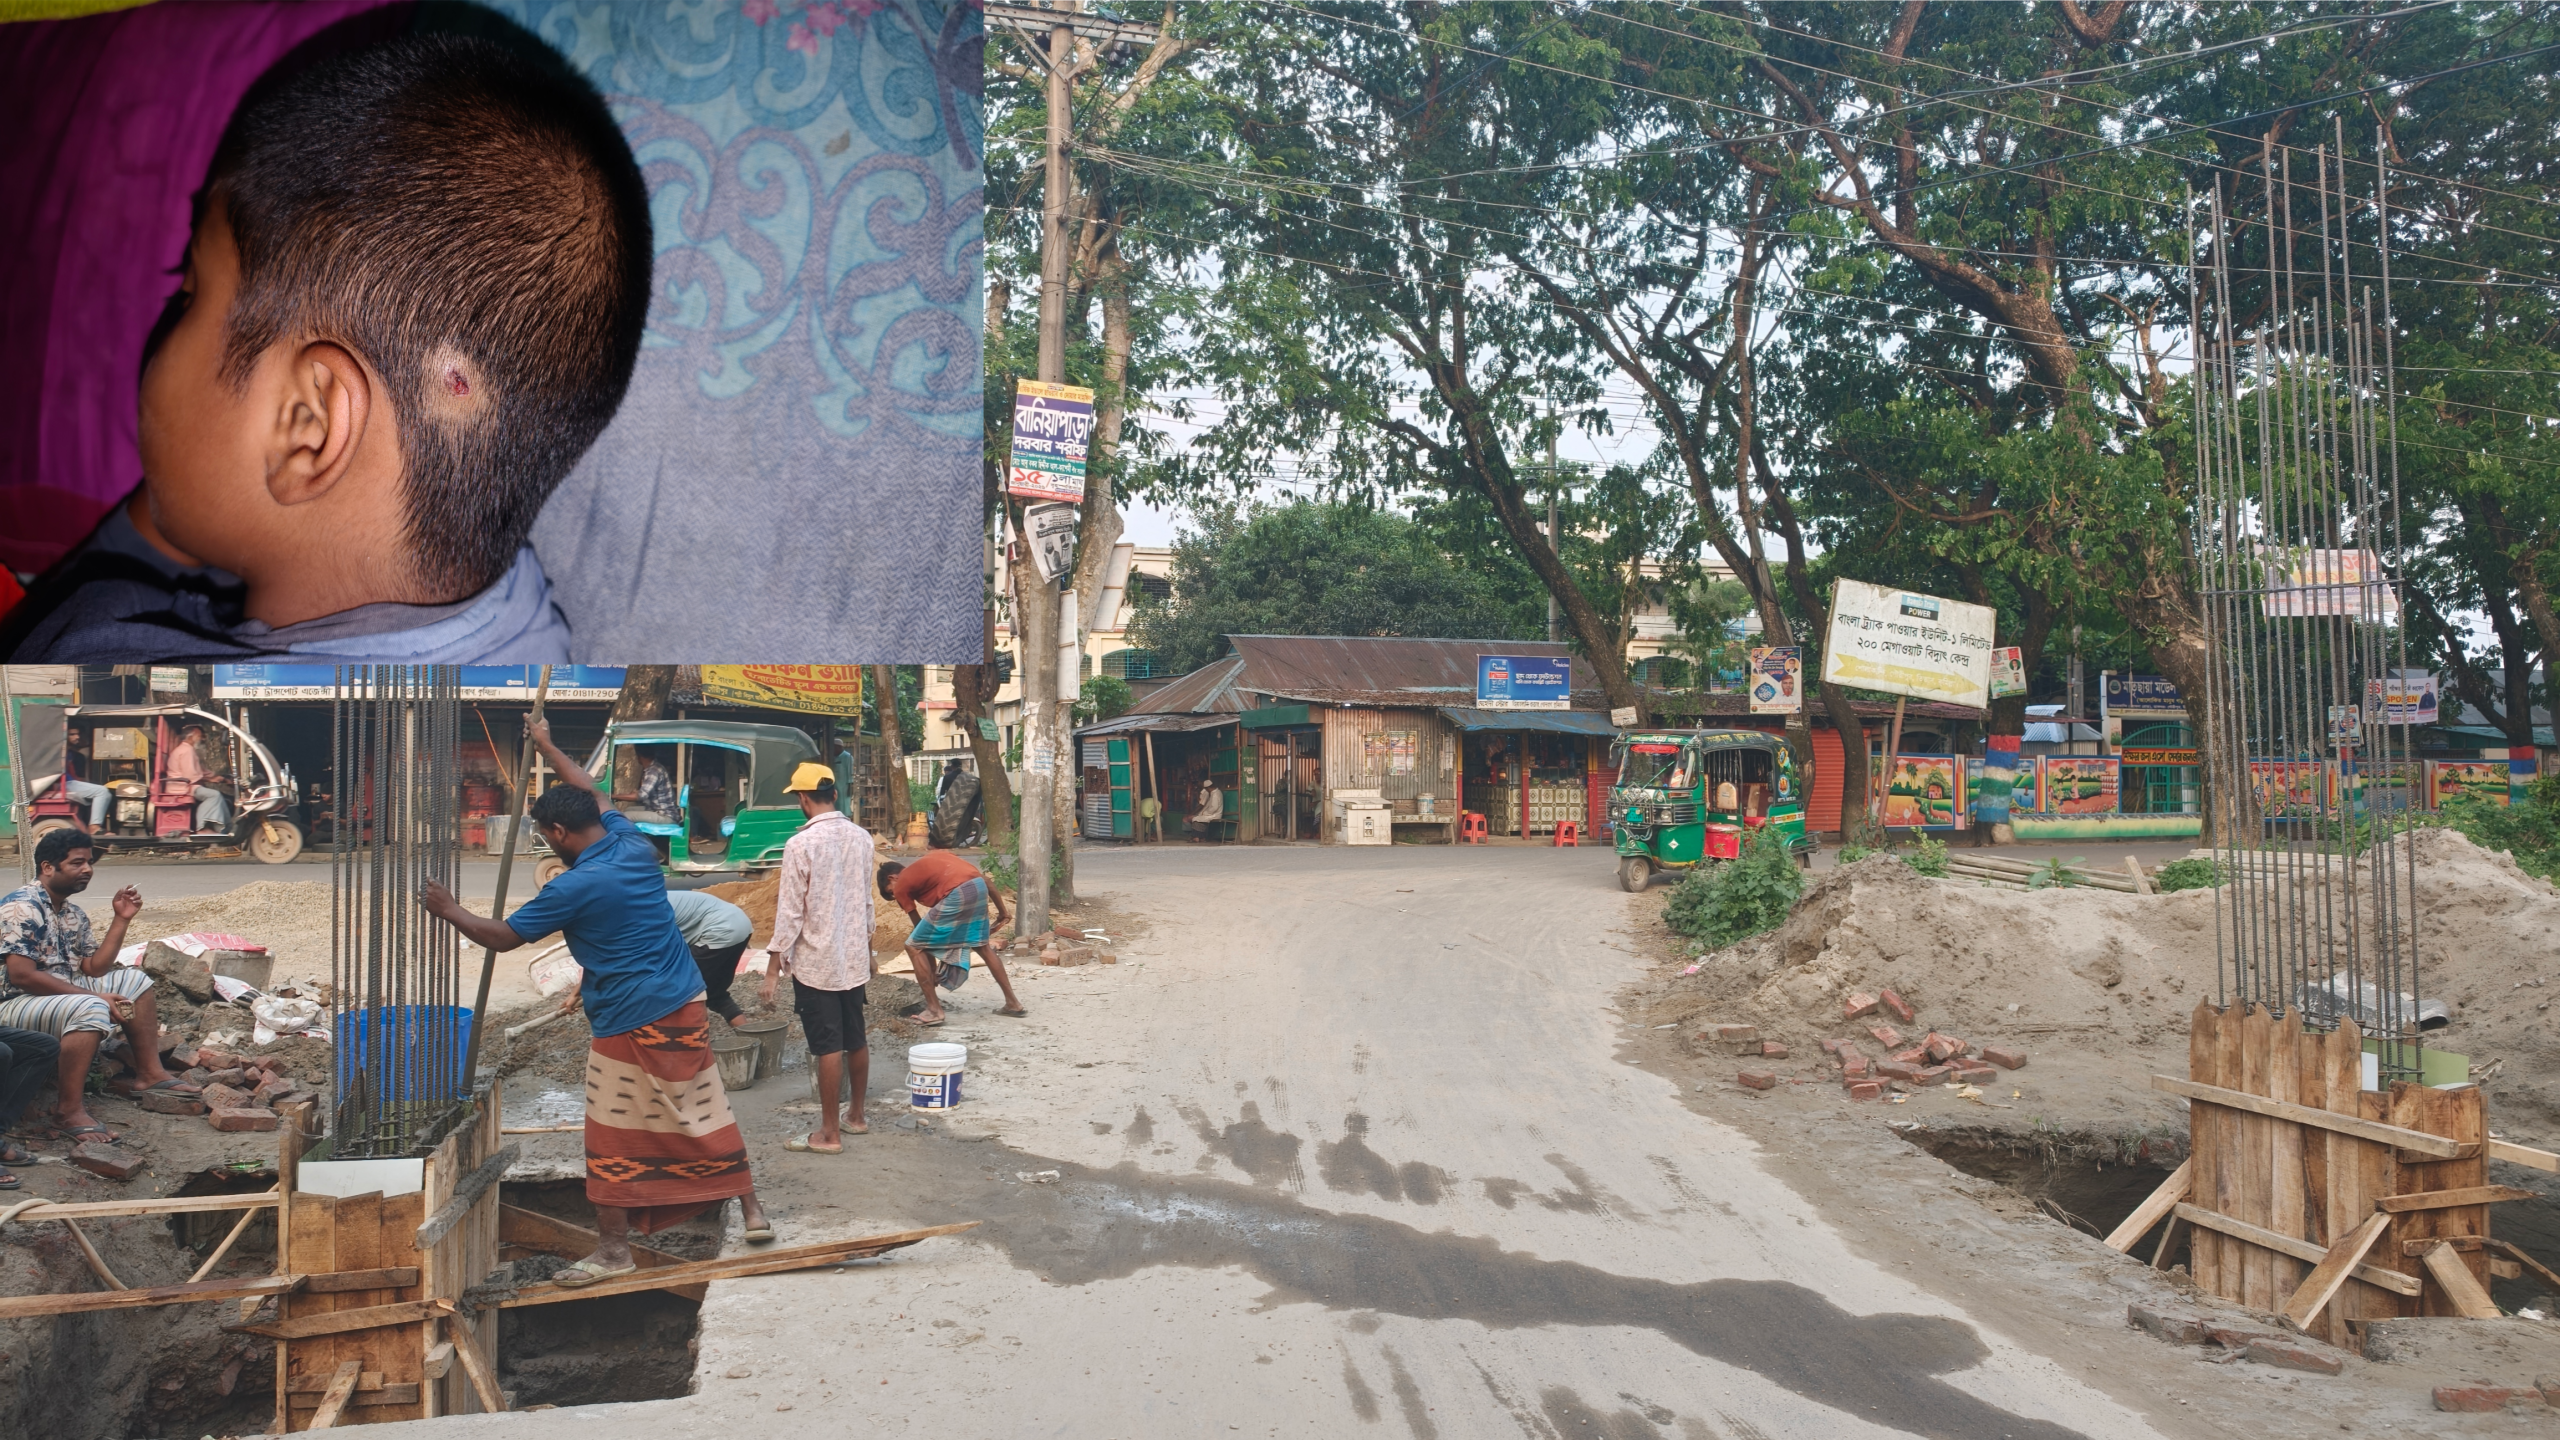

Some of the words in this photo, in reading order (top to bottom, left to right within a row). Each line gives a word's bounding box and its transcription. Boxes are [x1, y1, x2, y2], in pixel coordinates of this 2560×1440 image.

[1016, 397, 1090, 444] বানিয়াপাড়া
[1014, 436, 1052, 452] দরবার
[1055, 438, 1087, 457] শরীফ
[1014, 468, 1044, 484] ১৫
[1052, 474, 1072, 484] ১লা
[1908, 607, 1931, 618] POWER
[1838, 614, 1861, 627] বাংলা
[1887, 622, 1919, 638] পাওয়ার
[1921, 626, 1957, 645] ইউনিট-১
[1960, 633, 1992, 650] লিমিটেড
[1858, 637, 1877, 649] ২০০
[1881, 641, 1923, 657] মেগাওয়াট
[1926, 645, 1947, 664] বিদ্যুৎ
[1950, 653, 1970, 667] কেন্দ্র
[717, 676, 736, 686] বাংলা
[793, 681, 809, 691] স্কুল
[829, 684, 856, 692] কলেজ
[2154, 681, 2176, 694] মডেল
[2386, 695, 2417, 703] SPOEN
[800, 702, 830, 711] 01896
